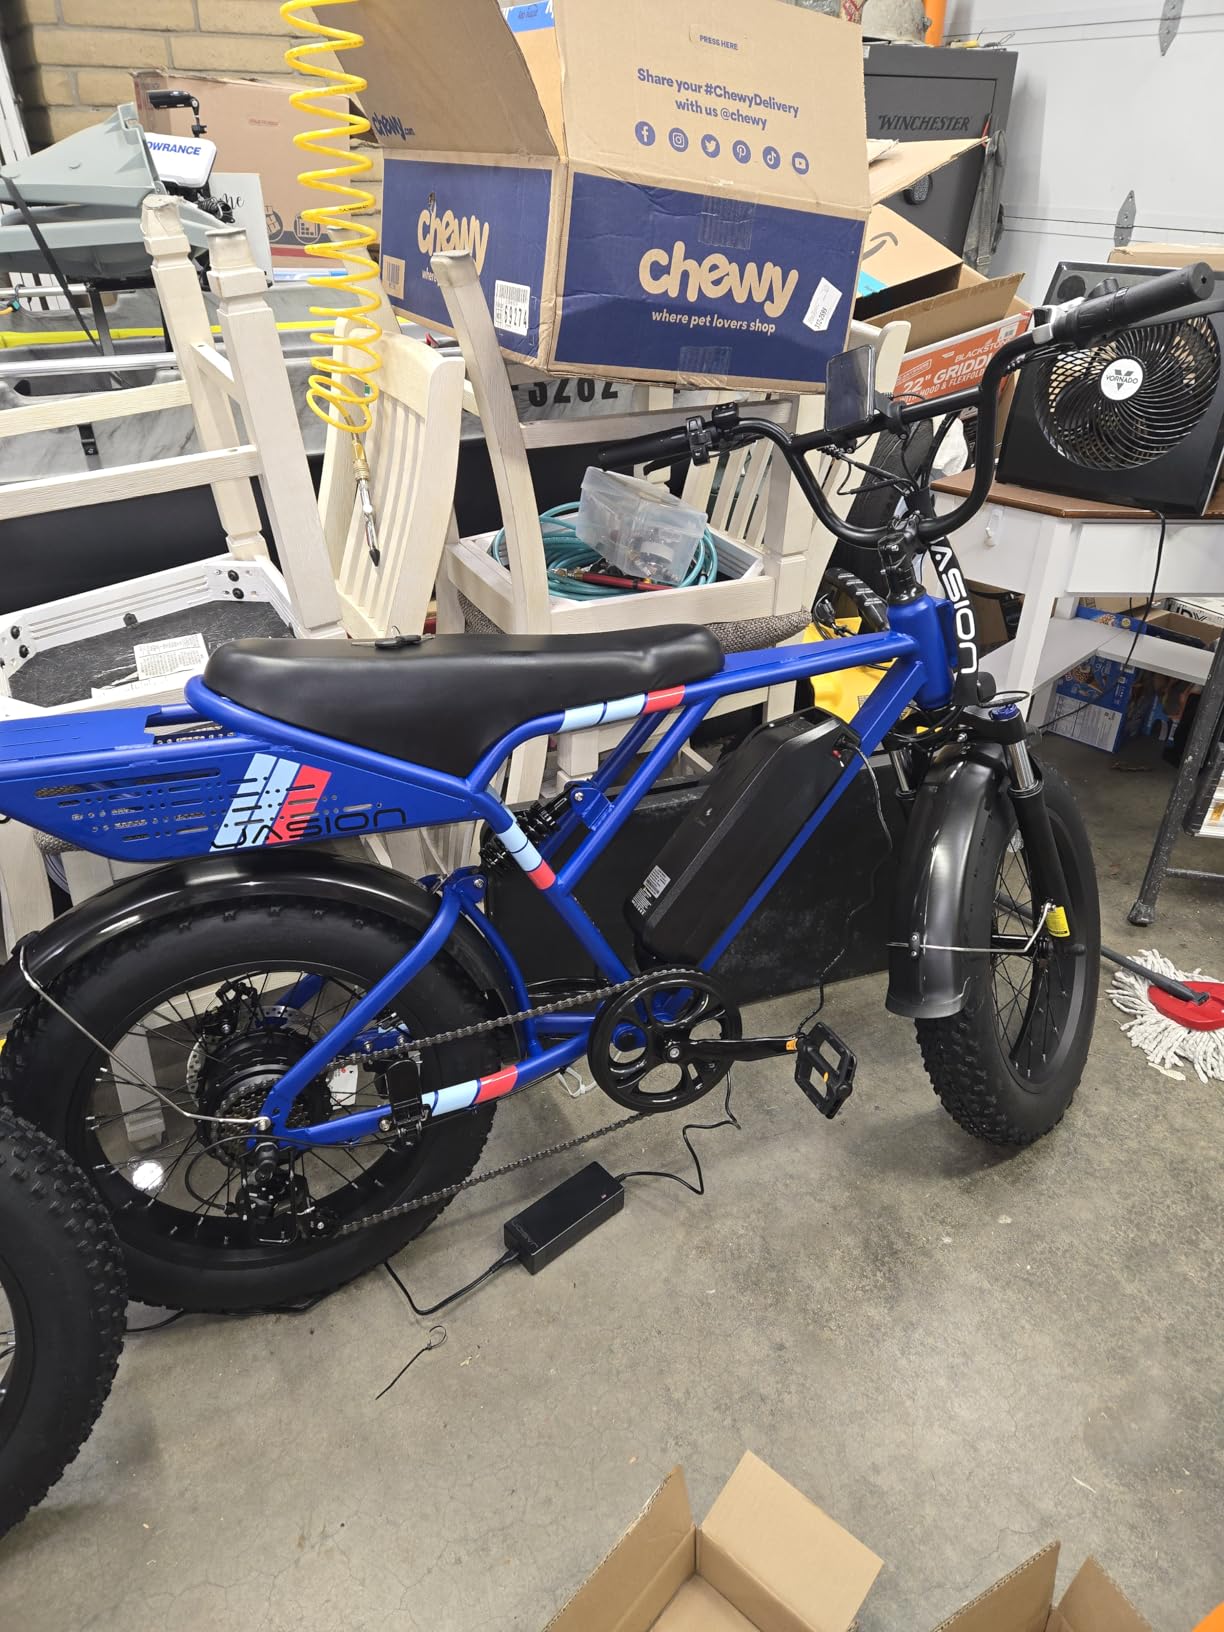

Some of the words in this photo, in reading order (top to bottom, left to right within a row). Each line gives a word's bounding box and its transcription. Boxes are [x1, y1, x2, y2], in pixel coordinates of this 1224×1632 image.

[699, 34, 720, 46] PRESS
[720, 40, 738, 50] HERE
[637, 68, 674, 88] Share
[675, 79, 703, 93] your
[704, 82, 799, 118] #ChewyDelivery
[675, 98, 703, 114] with
[705, 106, 718, 117] us
[720, 107, 767, 131] @chewy
[878, 114, 970, 131] WINCHESTER
[147, 141, 201, 156] OWRANCE
[417, 200, 490, 277] chewy
[638, 241, 799, 318] chewy
[652, 309, 688, 324] where
[690, 315, 711, 328] pet
[713, 314, 747, 330] lovers
[749, 318, 776, 335] shop
[929, 536, 978, 674] ASION
